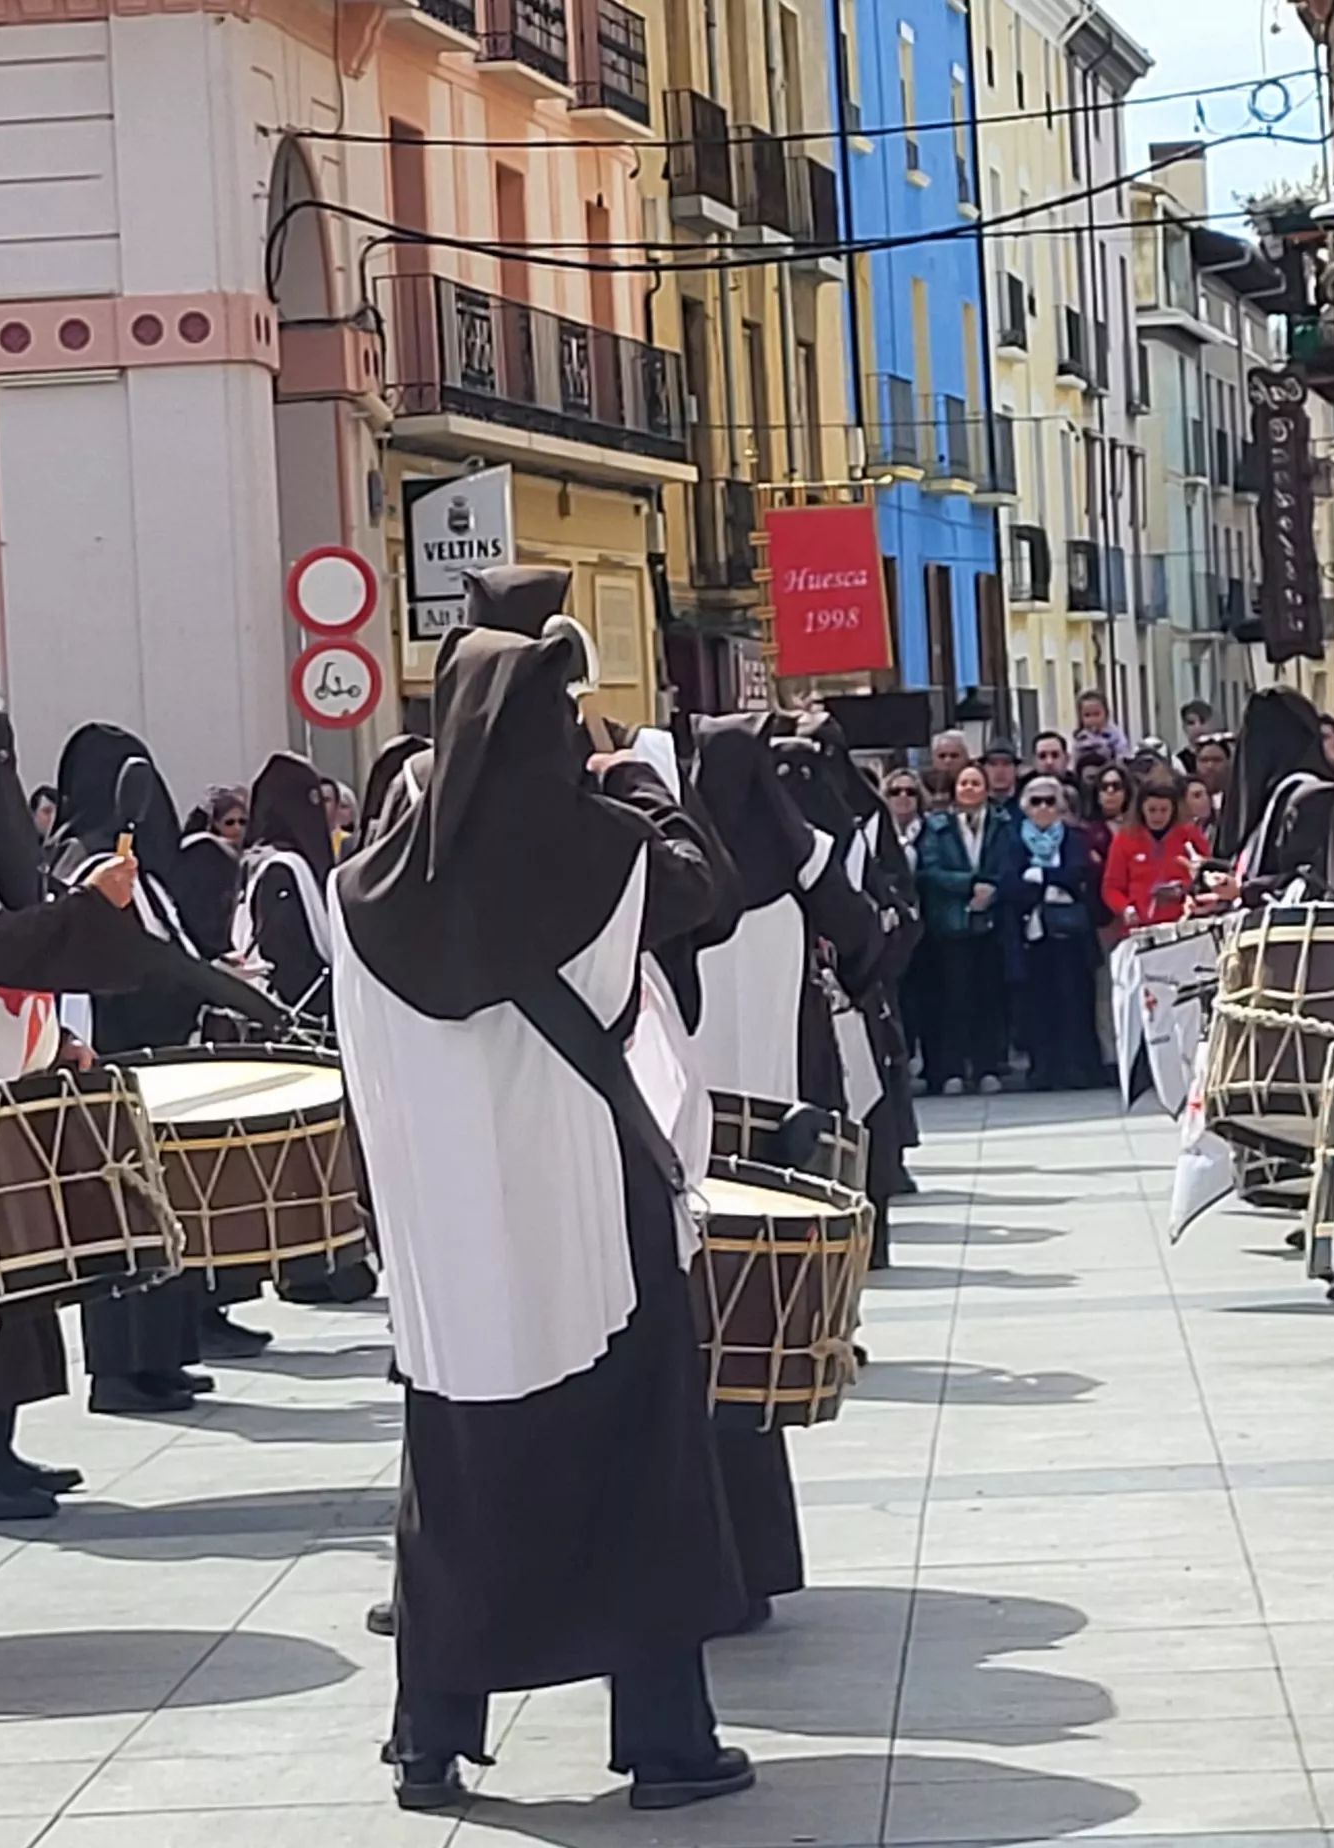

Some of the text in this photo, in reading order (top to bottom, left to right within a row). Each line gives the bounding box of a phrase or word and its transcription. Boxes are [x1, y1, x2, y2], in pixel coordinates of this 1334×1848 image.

[423, 537, 502, 562] VELTINS
[783, 567, 868, 593] Huesca
[805, 606, 861, 634] 1998
